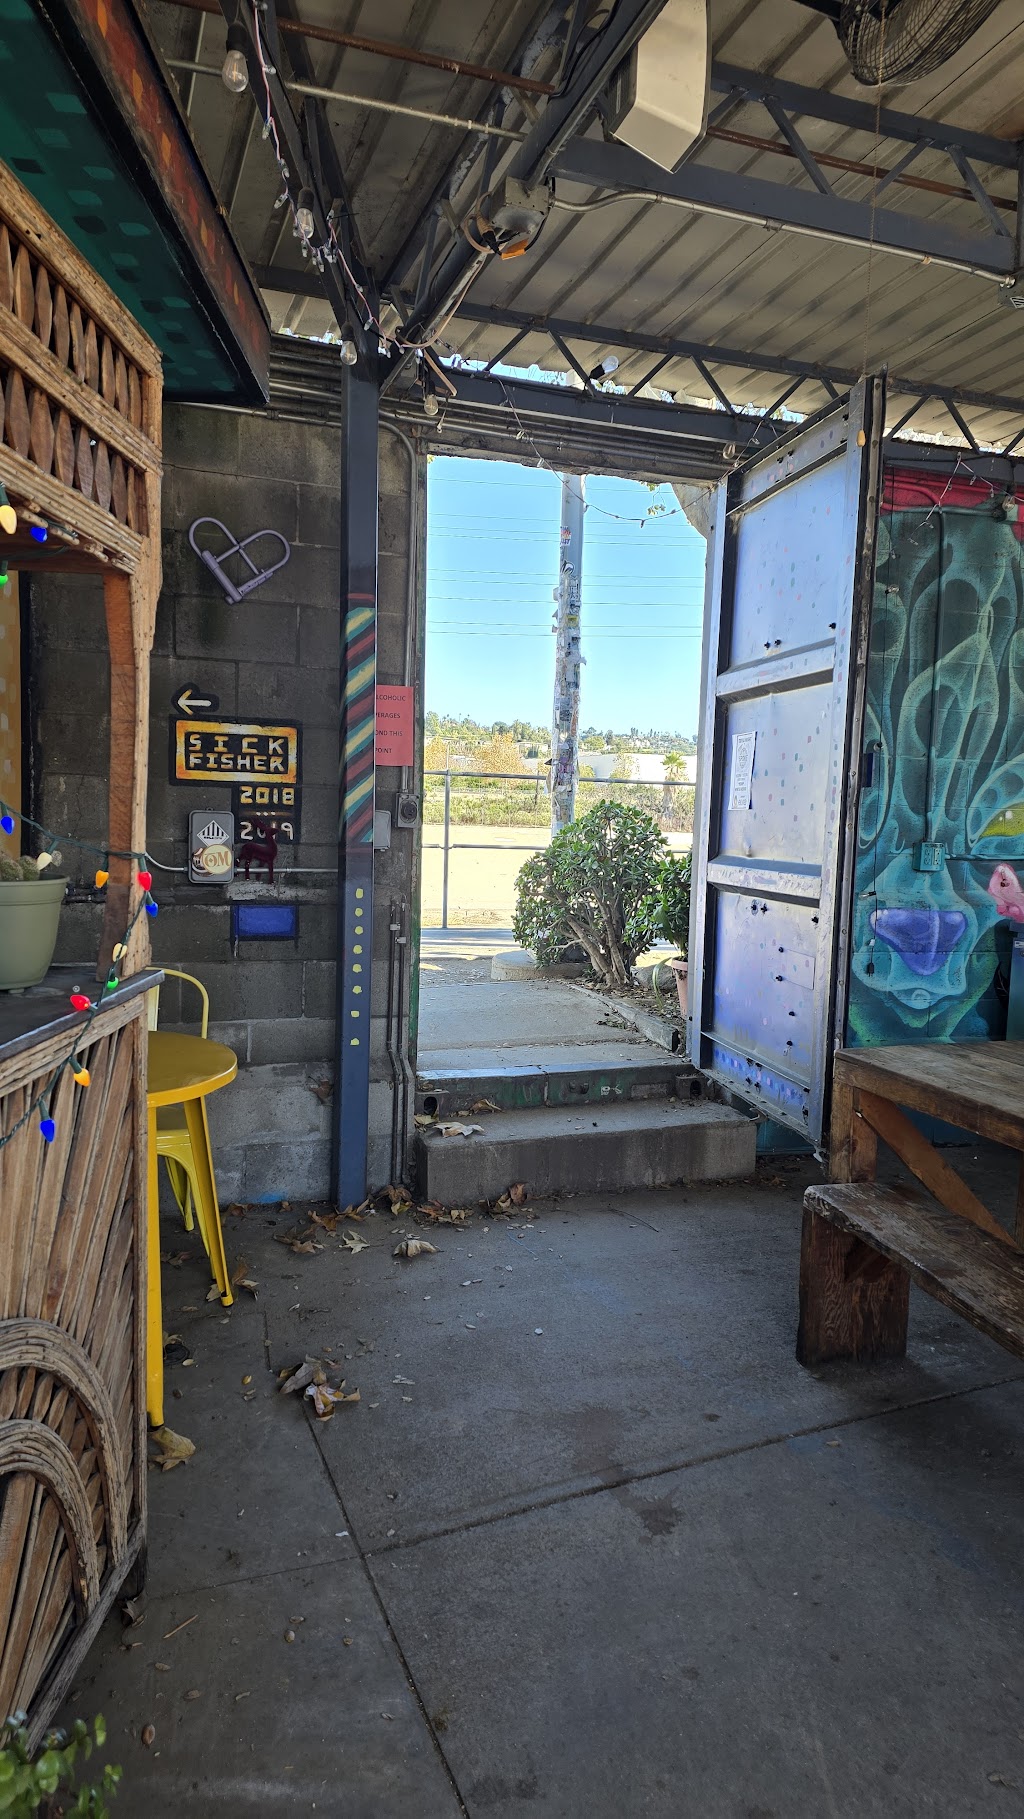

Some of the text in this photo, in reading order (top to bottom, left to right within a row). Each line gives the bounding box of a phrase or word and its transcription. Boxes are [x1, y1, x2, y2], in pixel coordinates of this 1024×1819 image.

[376, 694, 406, 702] LCOHOLIC
[188, 733, 285, 756] SICK
[188, 752, 286, 772] FISHER
[240, 785, 295, 806] 2018
